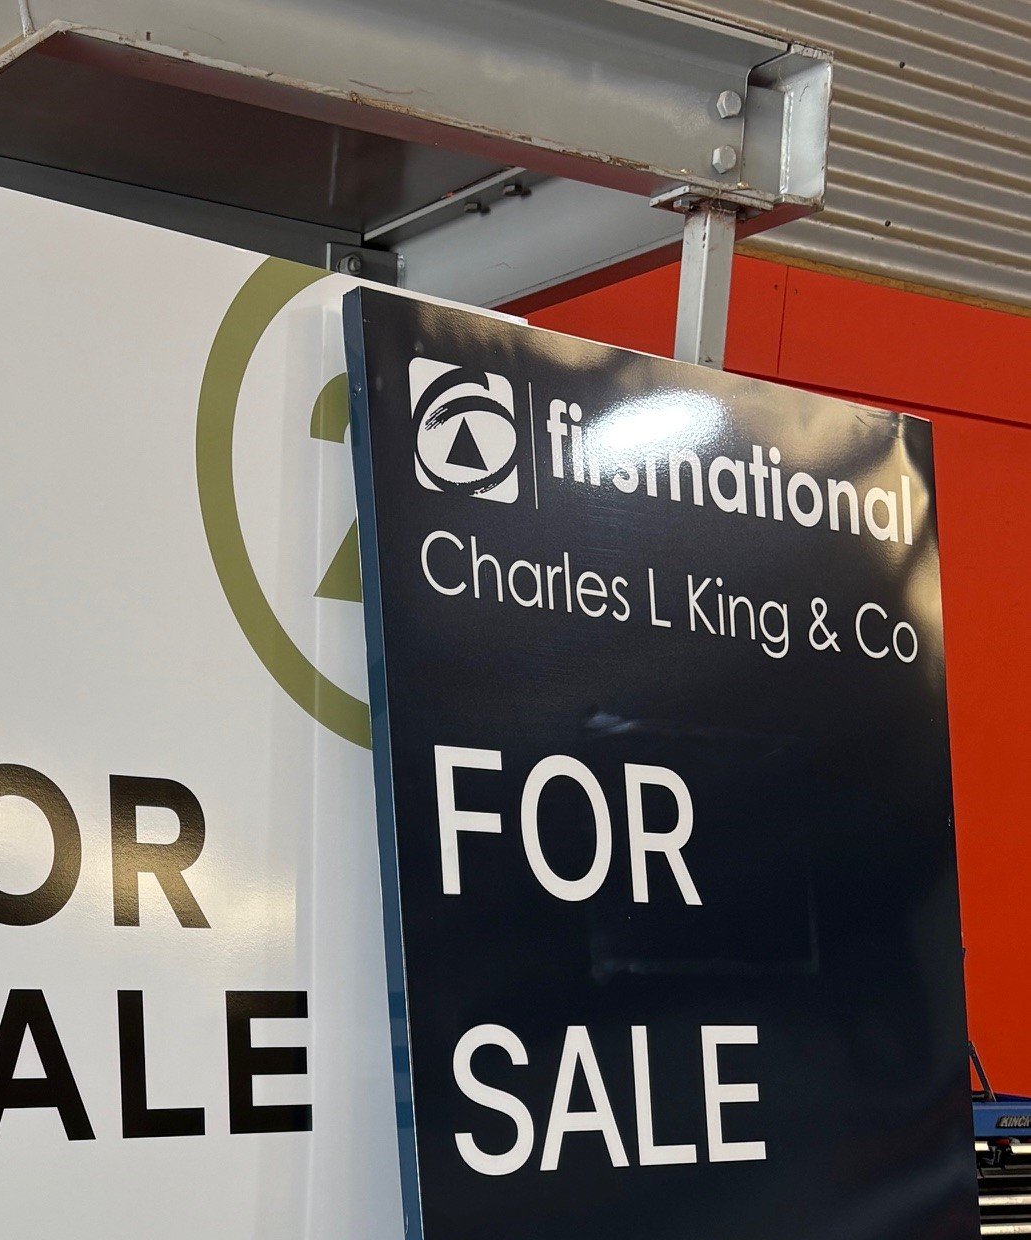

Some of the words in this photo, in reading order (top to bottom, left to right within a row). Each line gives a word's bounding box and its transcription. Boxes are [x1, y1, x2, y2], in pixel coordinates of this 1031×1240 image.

[420, 530, 631, 623] Charles
[648, 567, 672, 628] L
[687, 573, 789, 660] King
[808, 597, 841, 653] &
[855, 602, 919, 664] Co
[434, 744, 703, 906] FOR
[452, 1023, 767, 1177] SALE
